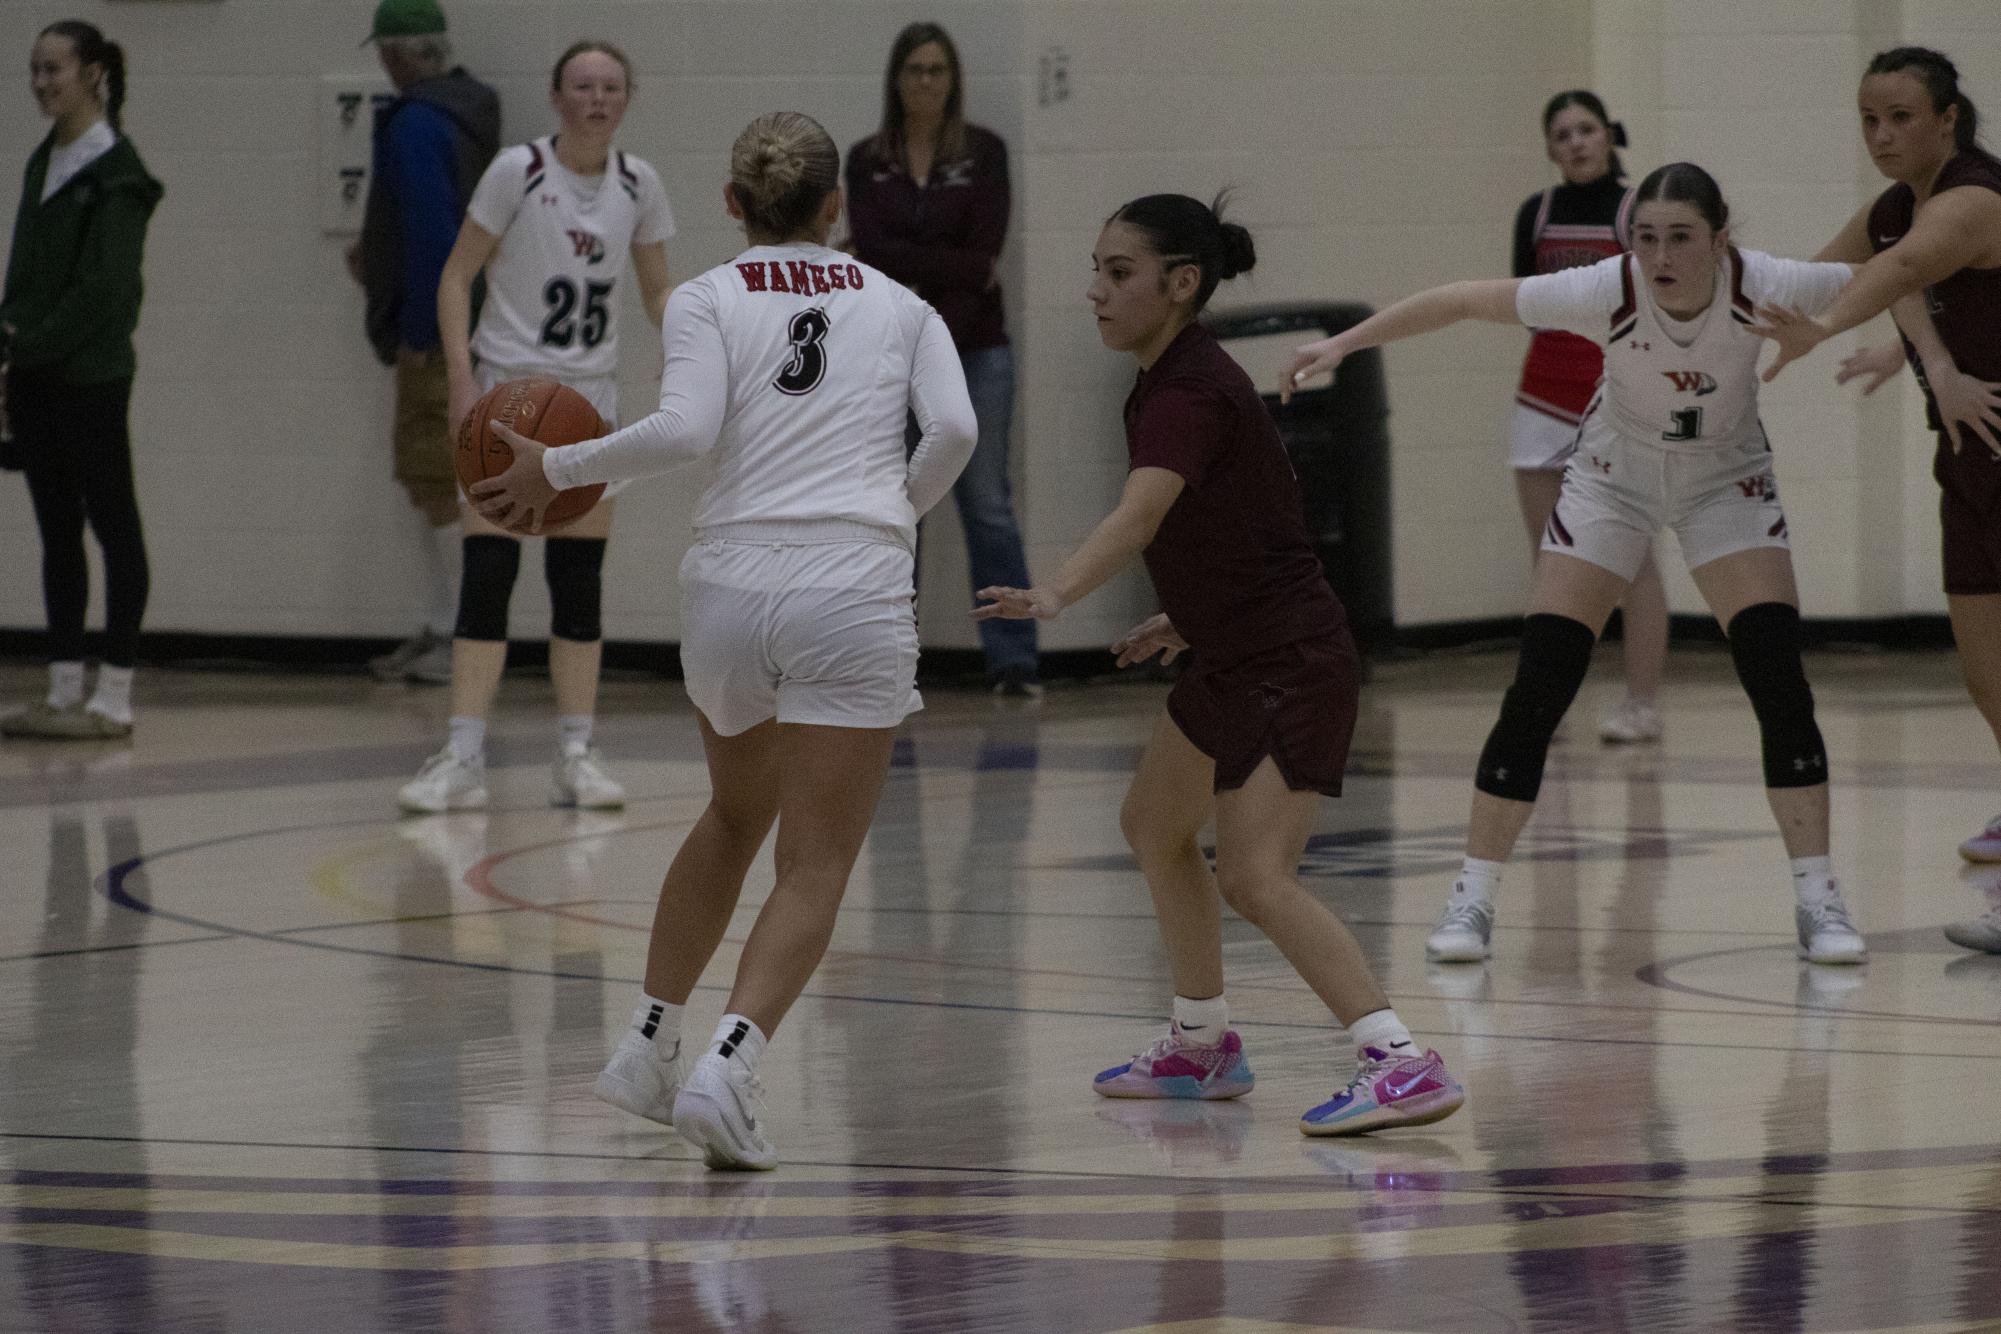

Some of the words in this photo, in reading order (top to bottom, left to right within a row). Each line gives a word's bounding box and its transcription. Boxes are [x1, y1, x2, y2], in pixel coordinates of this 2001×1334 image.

[542, 277, 615, 347] 25
[736, 260, 864, 297] WAMEGO
[772, 306, 831, 396] 3
